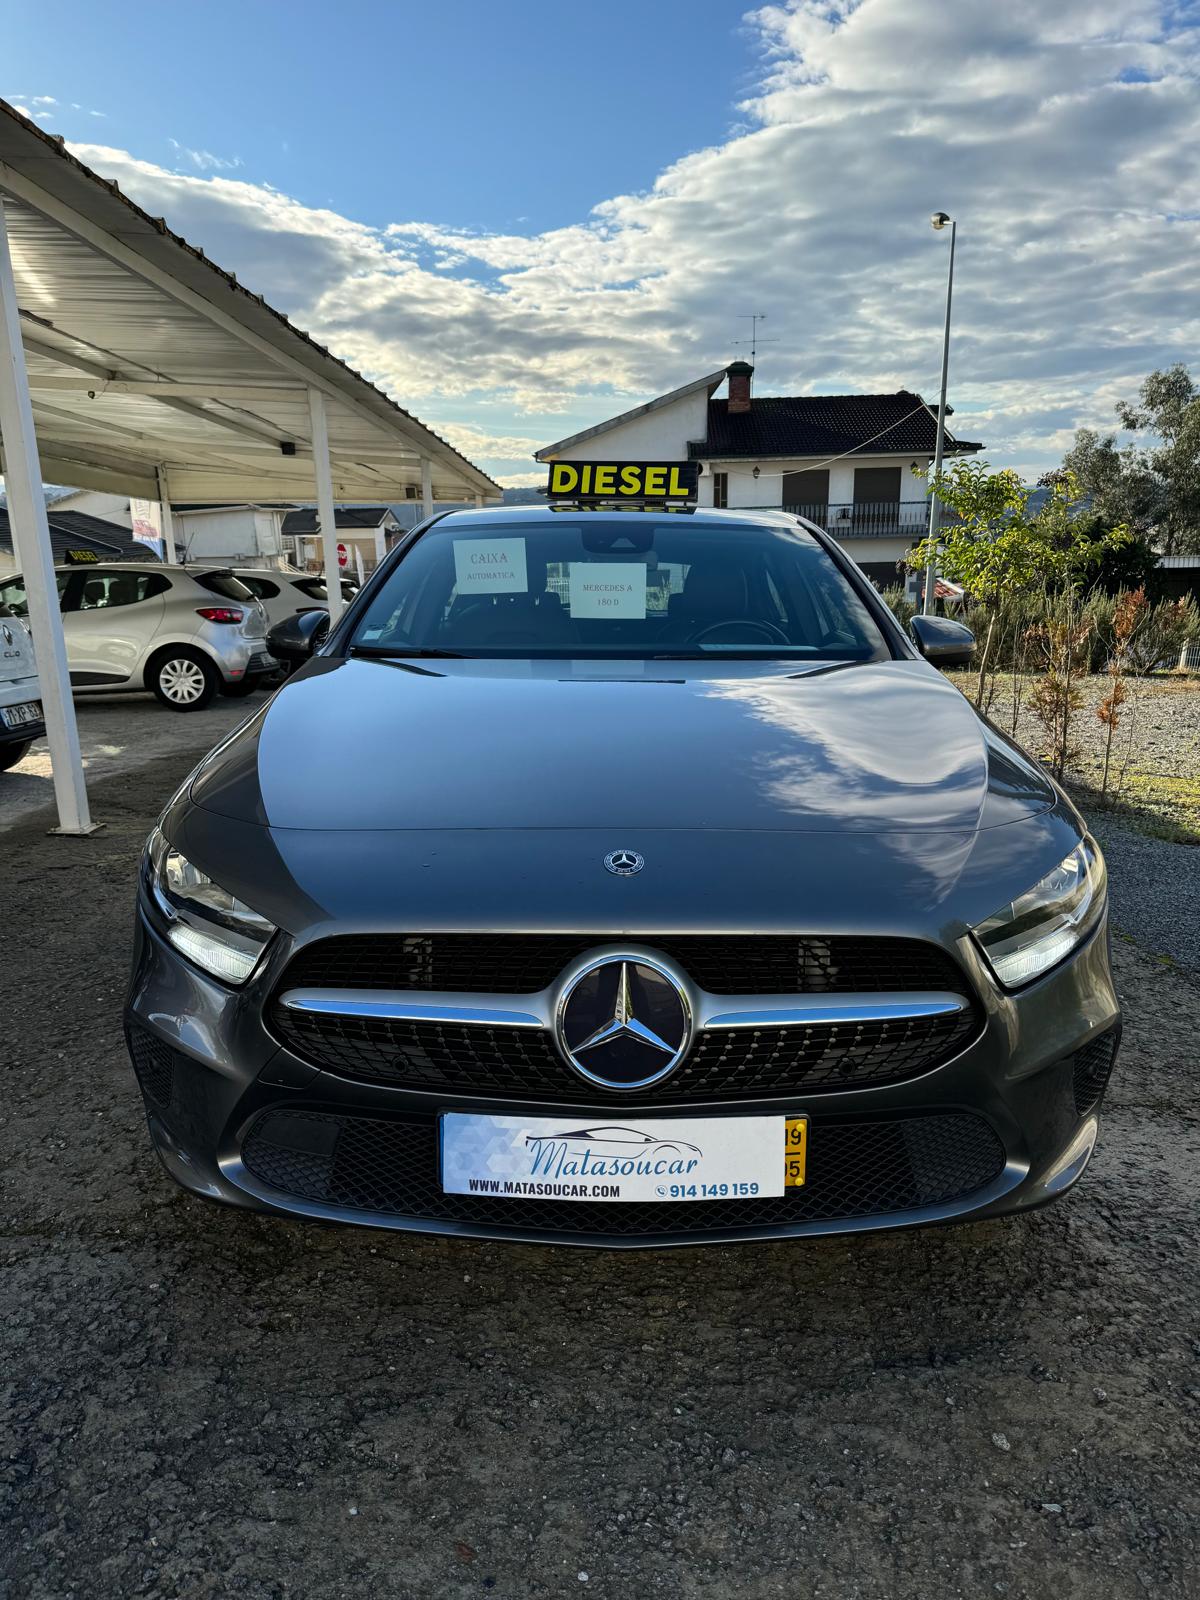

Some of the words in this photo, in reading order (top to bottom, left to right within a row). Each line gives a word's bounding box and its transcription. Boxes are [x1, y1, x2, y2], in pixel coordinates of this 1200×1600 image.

[551, 464, 689, 496] DIESEL
[470, 552, 509, 564] CAIXA
[467, 571, 515, 581] AUTOMATICA
[583, 584, 625, 592] MERCEDES
[626, 584, 633, 592] A
[529, 1139, 698, 1179] Matasoucar
[468, 1179, 621, 1198] WWW.MATASOUCAR.COM
[669, 1184, 697, 1198] 914
[701, 1184, 729, 1197] 149
[732, 1183, 759, 1196] 159
